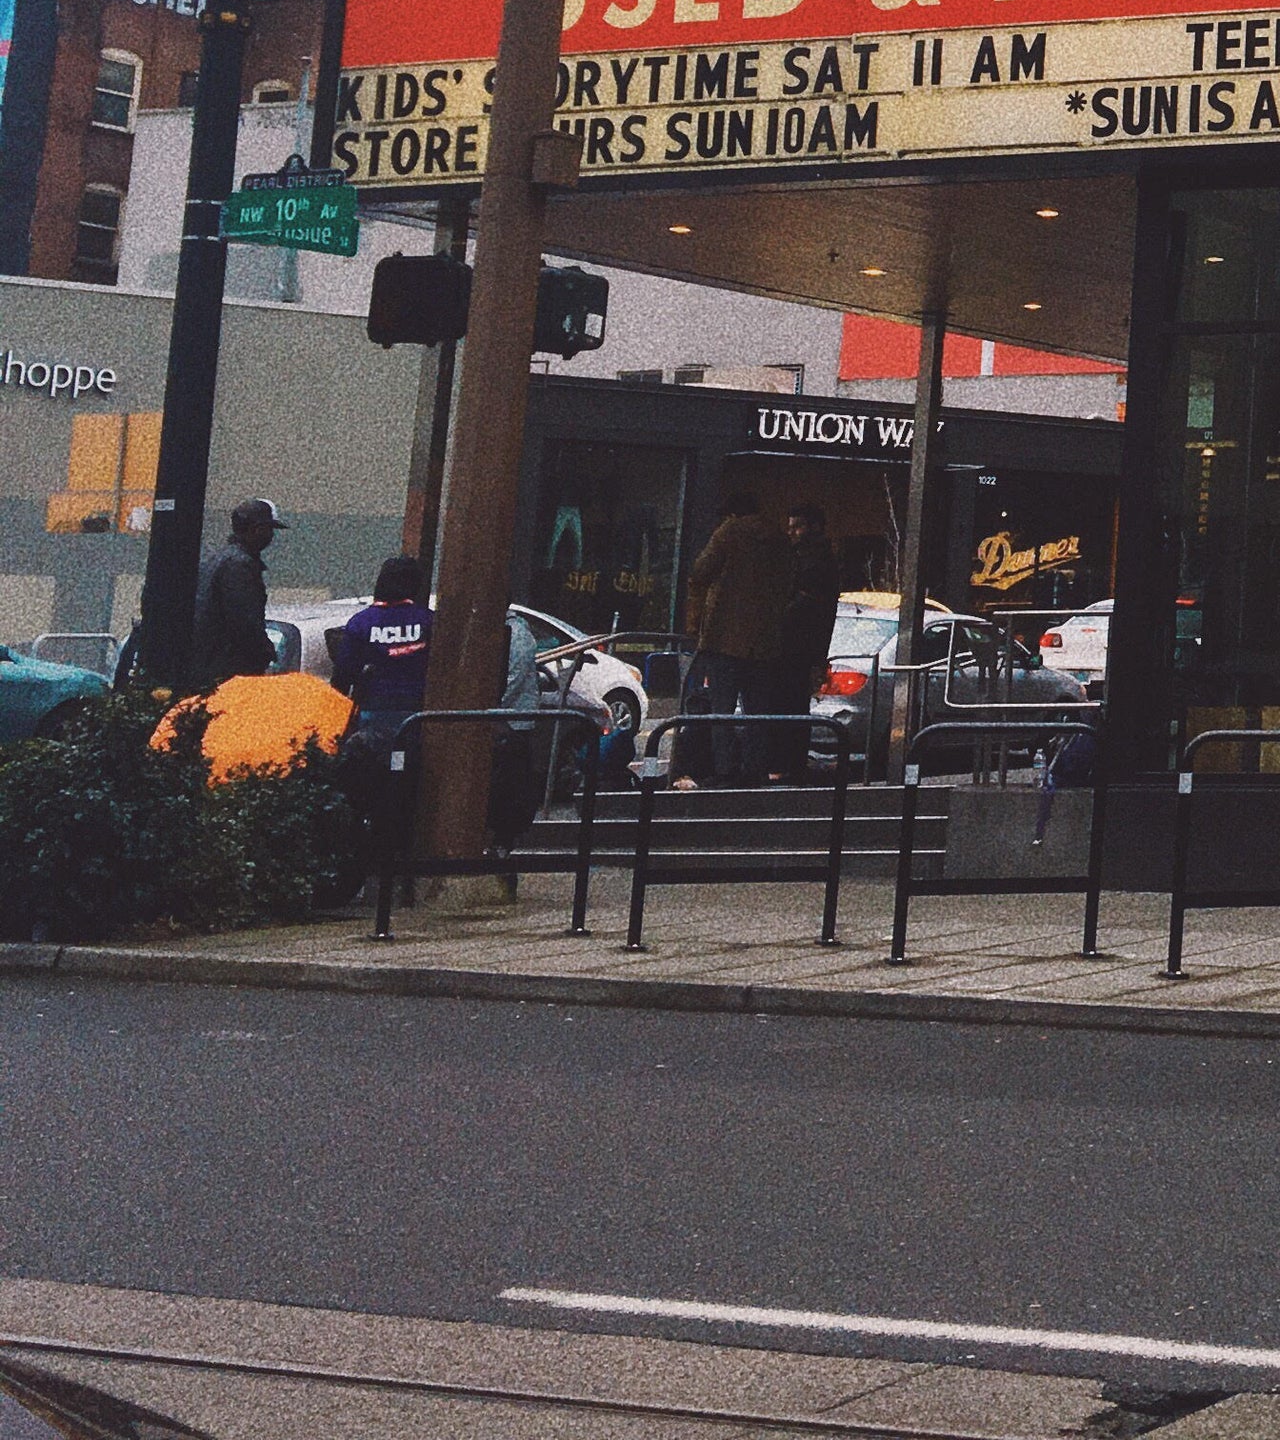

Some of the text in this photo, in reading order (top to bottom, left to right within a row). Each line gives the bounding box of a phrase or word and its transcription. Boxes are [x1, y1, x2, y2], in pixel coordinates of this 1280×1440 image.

[336, 69, 463, 121] KIDS'
[783, 44, 879, 94] SAT
[970, 33, 1046, 83] AM
[334, 125, 478, 178] STORE
[666, 110, 753, 161] SUN
[766, 102, 878, 157] 10AM
[240, 206, 265, 223] NW
[275, 198, 310, 221] 10th
[0, 350, 117, 398] hoppe
[758, 409, 869, 446] UNION
[979, 476, 997, 485] 1022
[369, 623, 421, 644] ACLU
